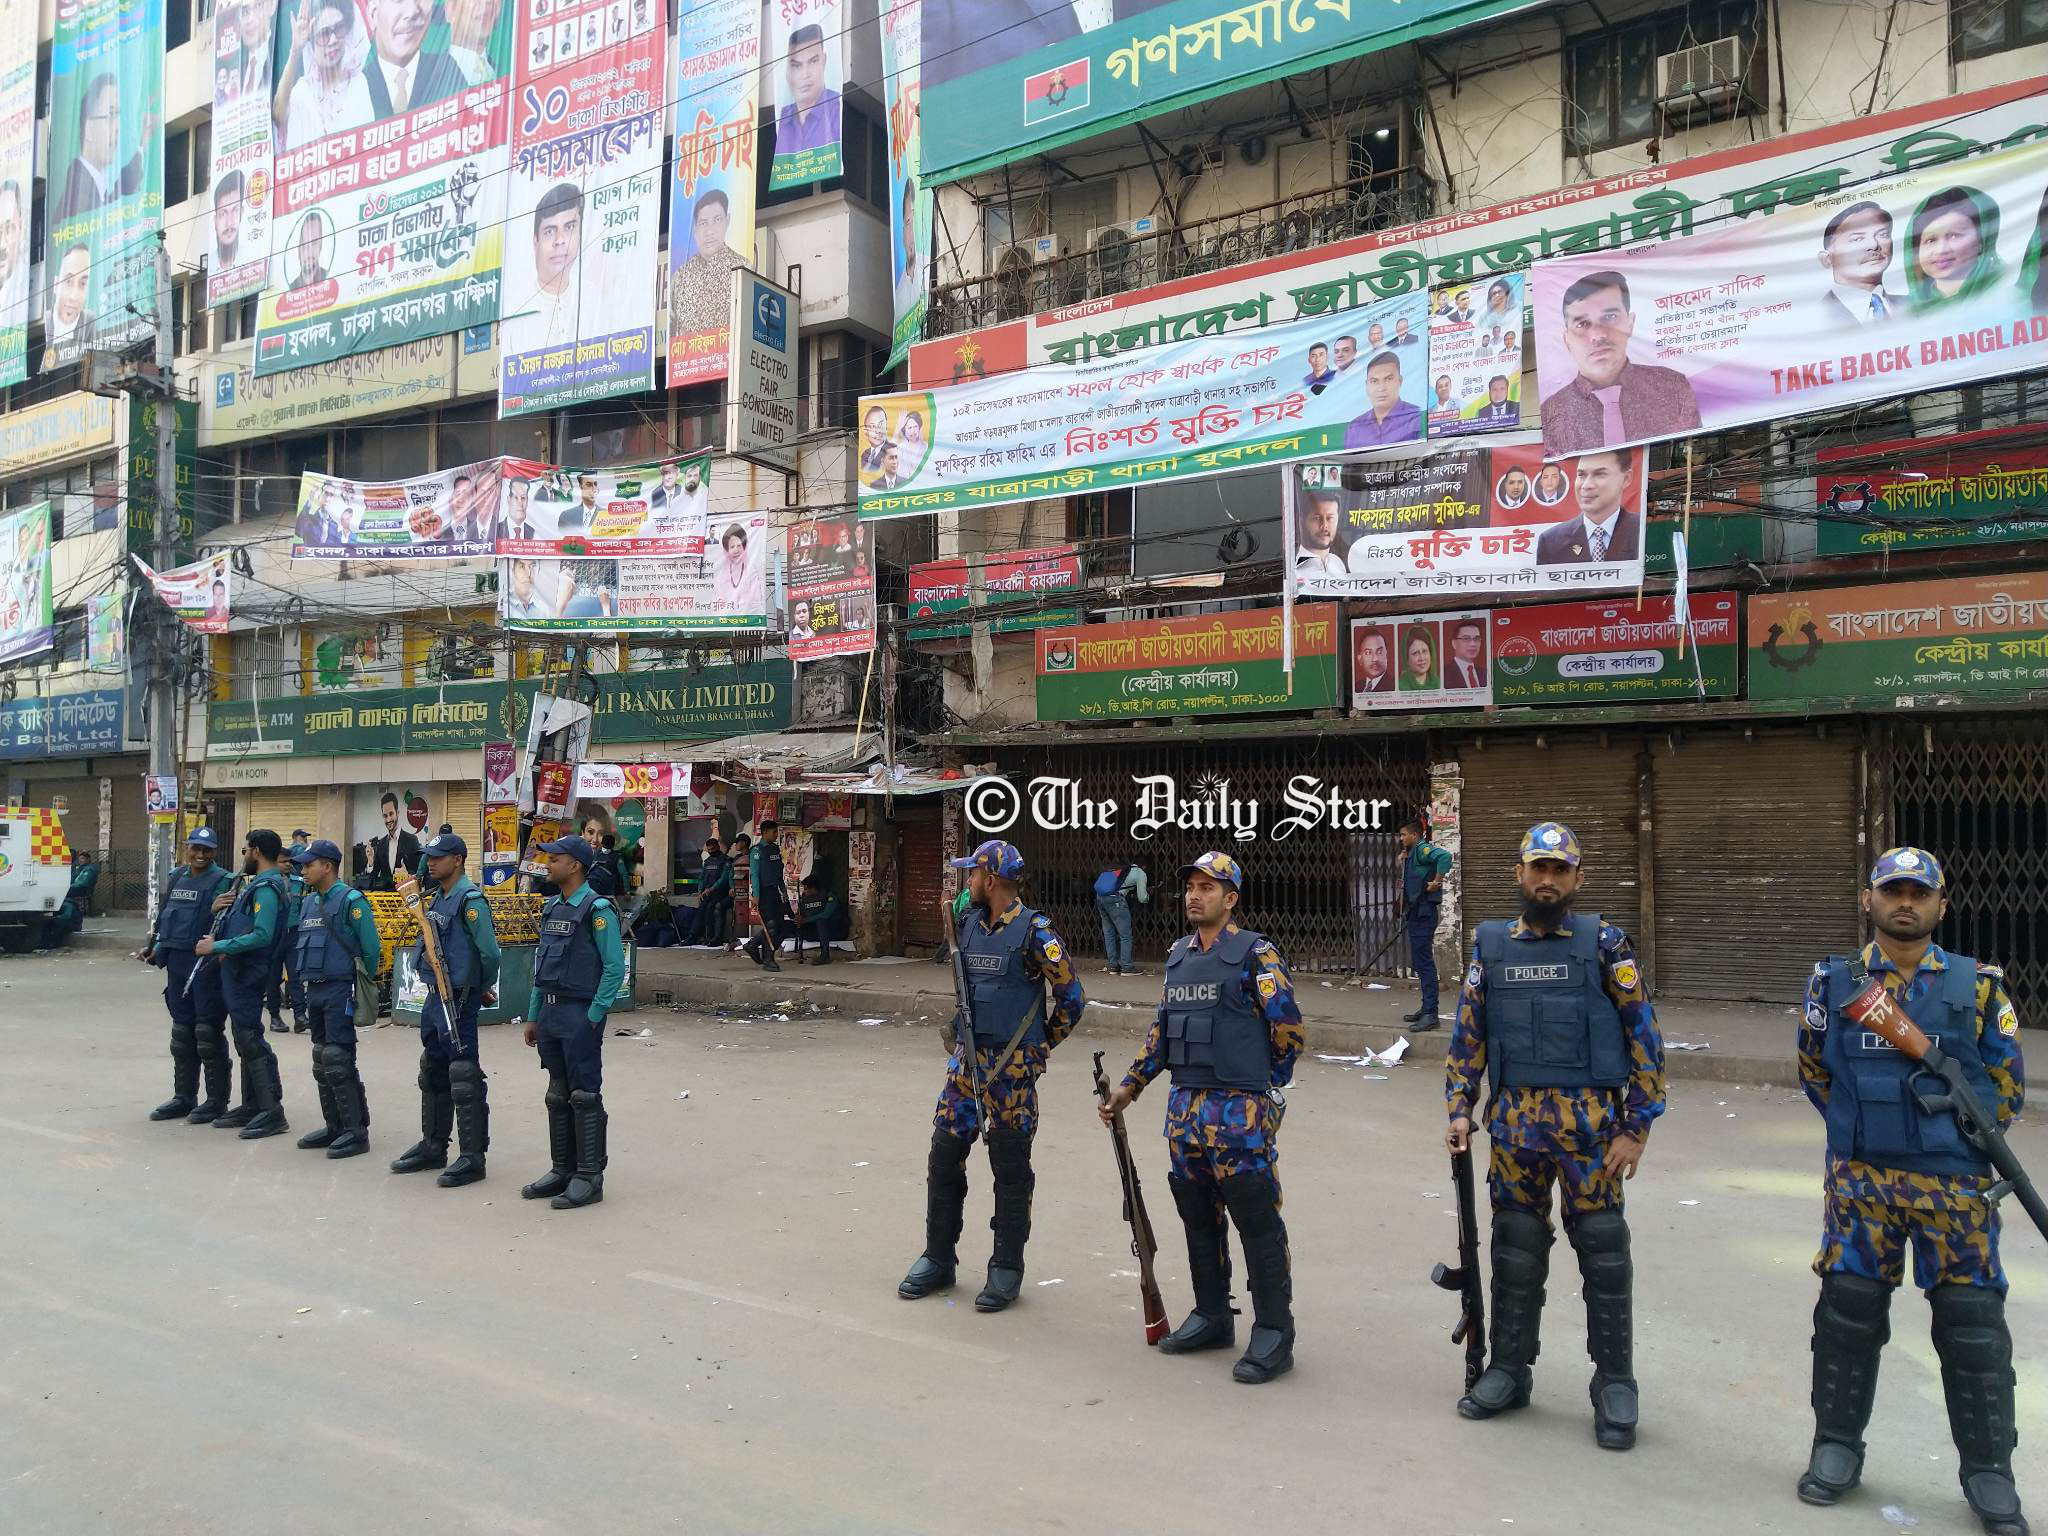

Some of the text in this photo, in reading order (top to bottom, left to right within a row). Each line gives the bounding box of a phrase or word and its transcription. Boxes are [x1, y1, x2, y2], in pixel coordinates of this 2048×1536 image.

[522, 86, 569, 135] ১০
[568, 107, 595, 128] ঢাকা
[600, 90, 649, 120] বিভাগীয়
[276, 134, 356, 181] বাংলাদেশ
[407, 123, 485, 167] রাজপথে
[517, 110, 657, 181] গণসমাবেশ
[677, 100, 756, 199] মুক্তি চাই
[594, 175, 653, 210] যোগ দিন
[1604, 168, 1670, 192] রাহিম
[363, 191, 389, 219] ১০
[603, 205, 639, 229] সফল
[358, 204, 443, 247] ঢাকা বিভাগীয়
[355, 220, 477, 279] গণ সমাবেশ
[602, 231, 637, 254] করুন
[1044, 184, 1702, 368] বাংলাদেশ জাতীয়তাবাদী
[1655, 274, 1766, 311] আহমেদ সাদিক
[288, 323, 337, 357] যুবদল,
[341, 308, 377, 337] ঢাকা
[381, 293, 447, 330] মহানগর
[451, 275, 499, 311] দক্ষিণ
[1051, 296, 1114, 322] বাংলাদেশ
[1699, 299, 1738, 317] সভাপতি
[1763, 301, 1793, 315] সংসদ
[750, 350, 789, 380] ELECTRO
[1771, 346, 1913, 395] TAKE BACK
[759, 376, 779, 398] FAIR
[953, 403, 972, 418] ১০ই
[1066, 377, 1114, 399] সফল
[1118, 367, 1166, 391] হোক
[1170, 355, 1225, 381] স্বার্থক
[1230, 345, 1281, 371] হোক
[742, 391, 795, 427] CONSUMERS
[1096, 400, 1143, 421] জাতীয়তাবাদী
[1144, 399, 1167, 414] যুবদল
[1169, 393, 1201, 410] যাত্রাবাড়ী
[1203, 386, 1226, 400] থানার
[1227, 383, 1242, 397] সহ
[1243, 376, 1277, 394] সভাপতি
[751, 418, 785, 444] LIMITED
[935, 391, 1308, 478] মুশফিকুর রহিম ফাহিম এর নিঃশর্ত মুক্তি চাই
[861, 433, 1305, 514] প্রচারেঃ যাত্রাবাড়ী থানা যুবদল
[1364, 462, 1469, 486] ছাত্রদল কেন্দ্রীয় সংসদের
[1423, 480, 1462, 496] সম্পাদক
[1880, 475, 1956, 513] বাংলাদেশ
[1348, 502, 1431, 530] মাকসুদুর রহমান
[305, 546, 350, 559] যুবদল,
[355, 544, 385, 557] ঢাকা
[388, 543, 449, 558] মহানগর
[452, 540, 495, 556] দক্ষিণ
[635, 540, 652, 549] এম
[1366, 529, 1536, 571] নিঃশর্ত মুক্তি চাই
[914, 571, 1073, 605] বাংলাদেশ কৃষকদল
[1309, 565, 1621, 591] বাংলাদেশ জাতীয়তাবাদী ছাত্রদল
[638, 619, 664, 627] ঢাকা
[1825, 604, 1946, 639] বাংলাদেশ
[1078, 618, 1330, 668] বাংলাদেশ জাতীয়তাবাদী দল
[1540, 626, 1598, 649] বাংলাদেশ
[1914, 636, 1992, 665] কেন্দ্রীয়
[1565, 652, 1658, 673] কেন্দ্রীয় কার্যালয়
[1970, 668, 1985, 682] ভি
[1986, 666, 2012, 682] আই
[2014, 666, 2029, 680] পি
[1121, 666, 1240, 698] (কেন্দ্রীয় কার্যালয়)
[1532, 681, 1546, 695] ভি
[1546, 681, 1567, 694] আই
[1568, 679, 1582, 692] পি
[618, 682, 776, 714] BANK LIMITED
[1079, 700, 1106, 716] ২৮/১,
[16, 692, 118, 733] ব্যাংক লিমিটেড
[270, 713, 294, 726] ATM
[358, 706, 408, 729] ব্যাংক
[411, 700, 489, 727] লিমিটেড
[655, 708, 775, 727] NAYAPALTAN BRANCH, DHAKA
[17, 727, 118, 746] Bank Ltd.
[469, 727, 488, 738] ঢাকা
[230, 768, 244, 779] ATM
[172, 890, 196, 900] POLICE
[967, 956, 998, 969] POLICE
[1514, 967, 1559, 979] POLICE
[1167, 983, 1219, 1003] POLICE
